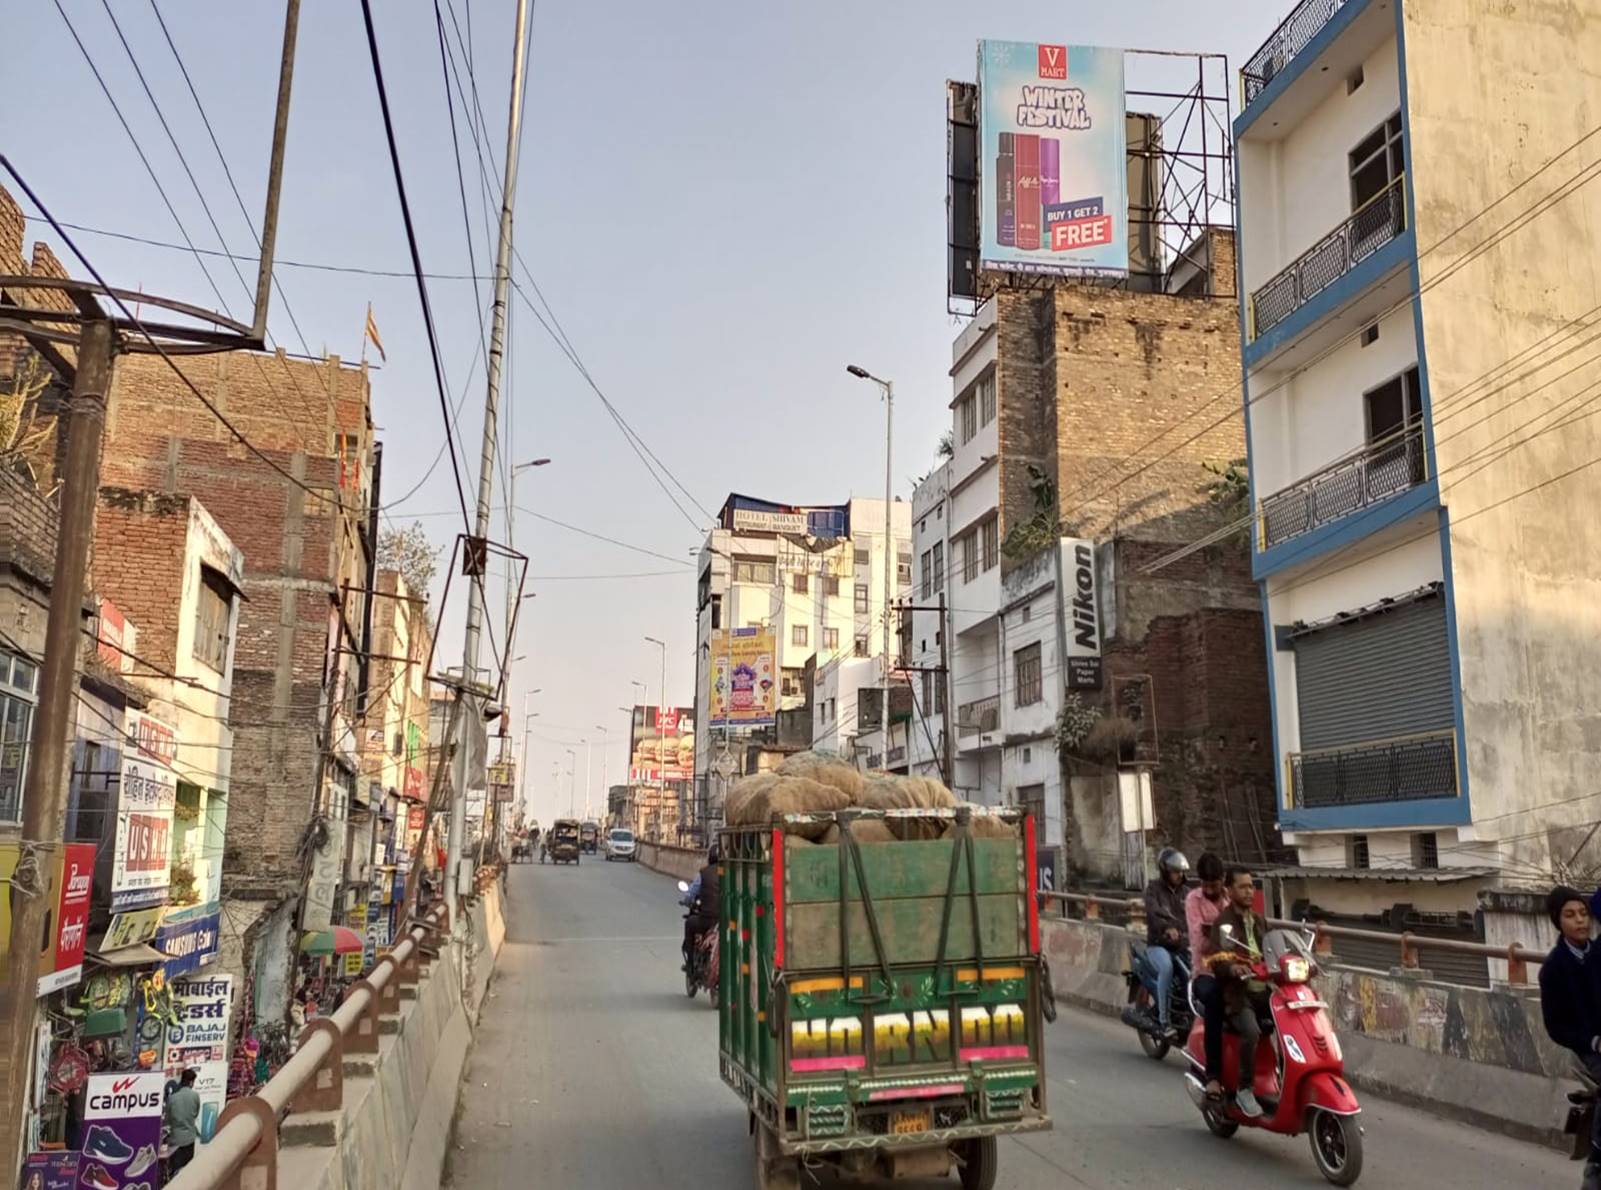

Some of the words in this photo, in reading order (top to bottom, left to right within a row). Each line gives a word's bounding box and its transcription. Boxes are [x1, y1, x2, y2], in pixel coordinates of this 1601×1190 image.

[1045, 47, 1060, 67] V
[1040, 66, 1065, 78] MART
[1022, 85, 1085, 110] WINTER
[1017, 103, 1092, 130] FESTIVAL
[1047, 211, 1066, 221] BUY
[1067, 209, 1072, 219] 1
[1073, 207, 1091, 218] GET
[1092, 206, 1099, 215] 2
[735, 511, 769, 522] HOTEL
[772, 514, 805, 524] SHIVAM
[1073, 544, 1098, 650] Nikon
[139, 721, 173, 759] USHA
[128, 820, 169, 867] USHA
[173, 977, 230, 998] मोबाईल
[185, 1033, 226, 1043] FINSERV
[186, 1024, 227, 1033] BAJAJ
[89, 1092, 160, 1112] campus
